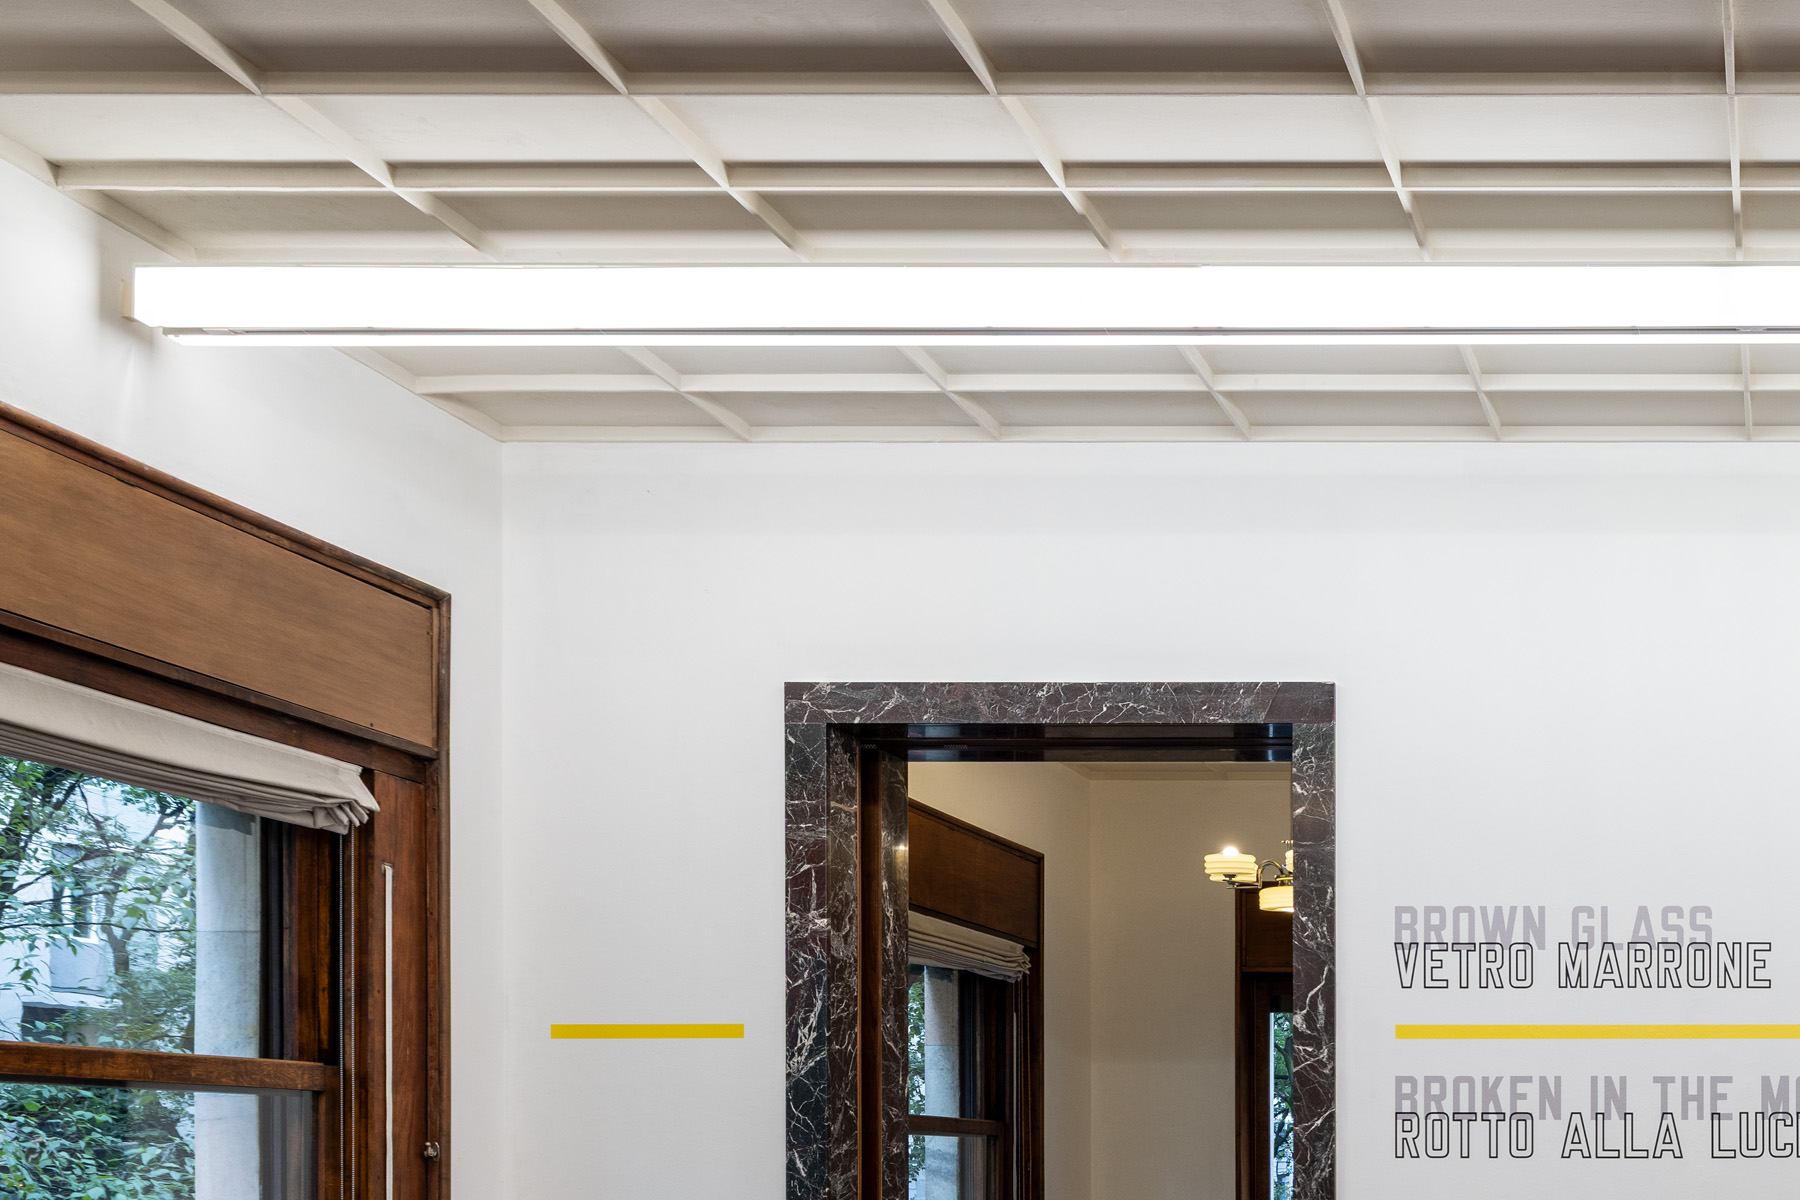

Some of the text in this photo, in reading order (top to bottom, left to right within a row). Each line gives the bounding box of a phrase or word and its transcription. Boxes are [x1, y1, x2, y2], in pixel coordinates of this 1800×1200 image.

[1394, 905, 1713, 950] BROWN GLASS
[1394, 942, 1772, 989] VETRO MARRONE
[1394, 1075, 1562, 1121] BROKEN
[1590, 1075, 1627, 1121] IN
[1653, 1075, 1734, 1121] THE
[1394, 1112, 1535, 1159] ROTTO
[1560, 1112, 1683, 1159] ALLA
